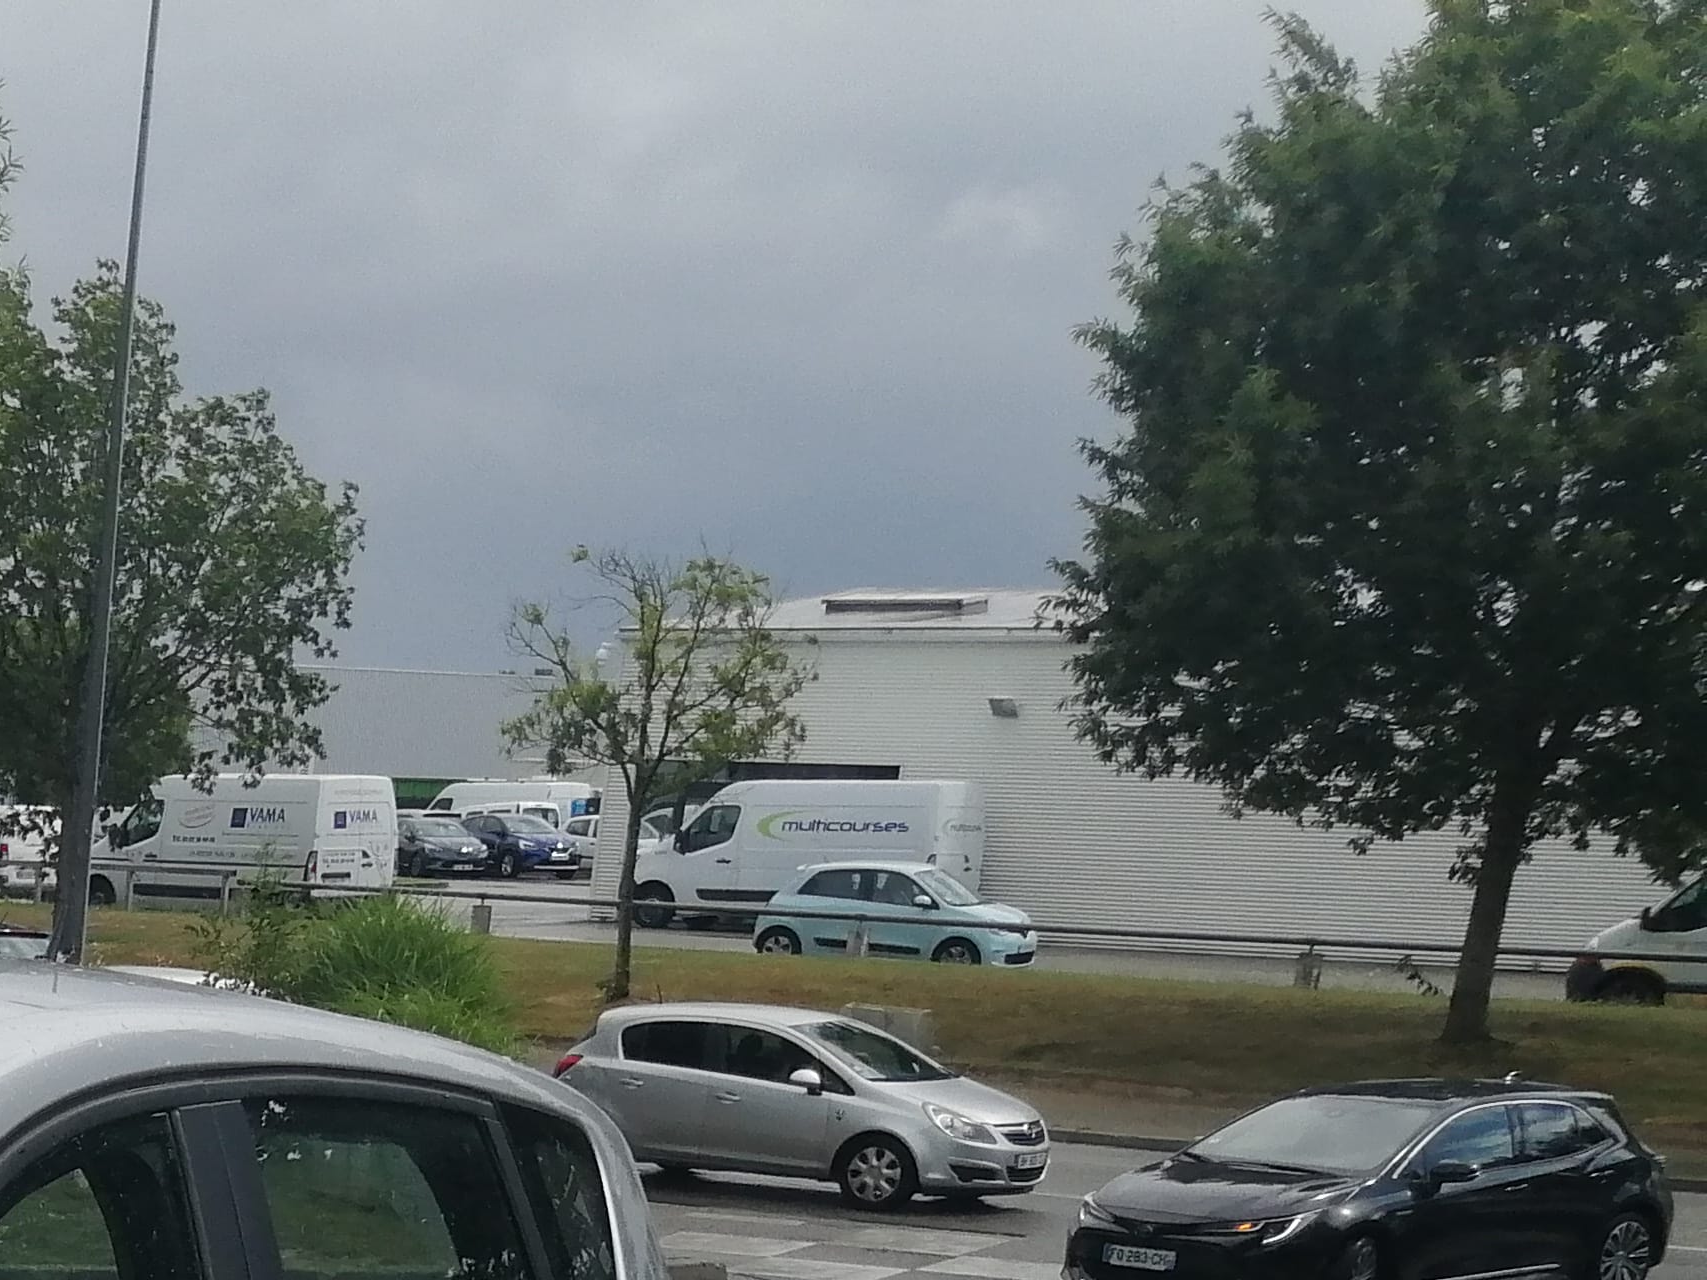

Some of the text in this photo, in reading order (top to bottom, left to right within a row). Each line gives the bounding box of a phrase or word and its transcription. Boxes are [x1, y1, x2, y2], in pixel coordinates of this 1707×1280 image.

[249, 807, 285, 822] VAMA
[348, 809, 378, 823] VAMA
[781, 818, 909, 834] multicourses
